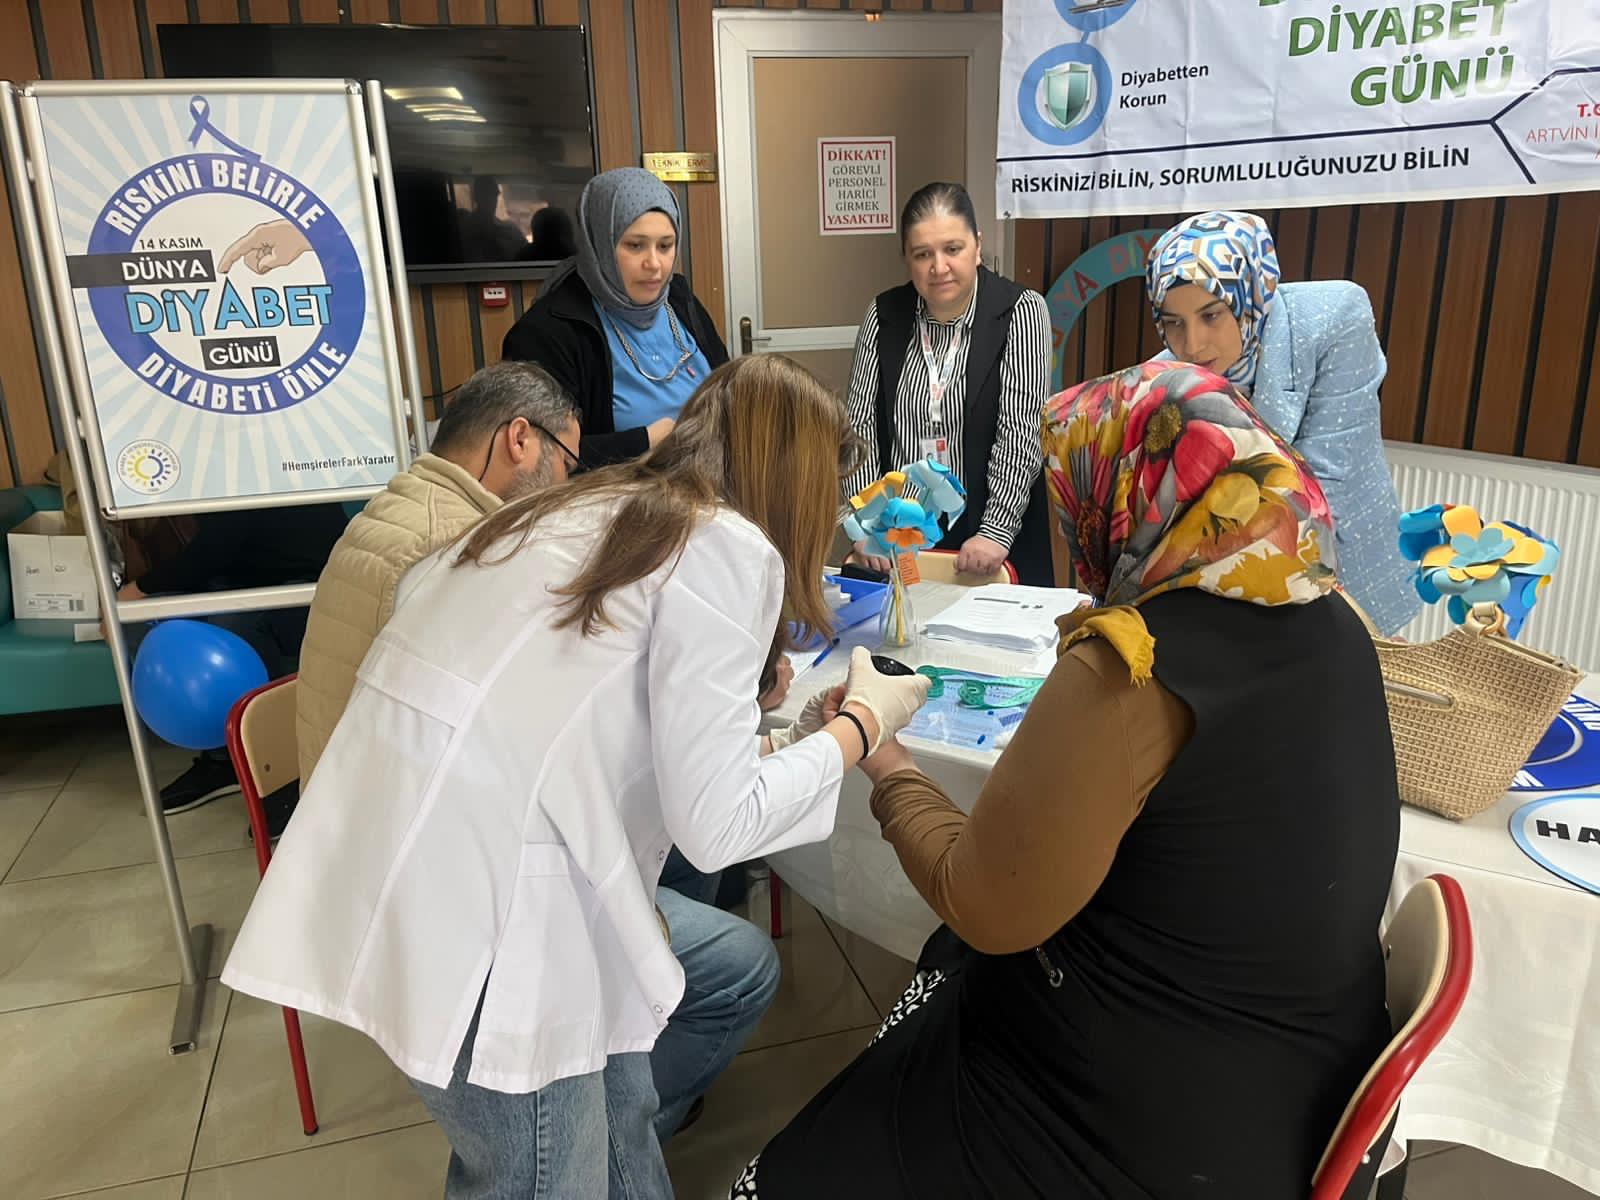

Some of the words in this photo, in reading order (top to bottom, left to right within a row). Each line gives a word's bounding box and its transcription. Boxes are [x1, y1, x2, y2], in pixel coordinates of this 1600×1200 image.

[1289, 0, 1518, 56] DİYABET
[1121, 65, 1209, 89] Diyabetten
[1351, 46, 1514, 106] GÜNÜ
[1119, 94, 1167, 109] Korun
[828, 147, 886, 161] DİKKAT!
[832, 164, 881, 175] GÖREVLİ
[1011, 172, 1097, 194] RİSKİNİZİ
[1099, 167, 1154, 190] BİLİN,
[1160, 153, 1396, 187] SORUMLULUĞUNUZU
[1404, 146, 1470, 170] BİLİN
[828, 177, 886, 188] PERSONEL
[104, 160, 201, 236] RİSKİNİ
[211, 159, 325, 230] BELİRLE
[838, 189, 876, 199] HARİCİ
[835, 201, 879, 211] GİRMEK
[827, 213, 889, 225] YASAKTIR
[138, 239, 157, 250] 14
[160, 237, 203, 249] KASIM
[121, 257, 209, 282] DÜNYA
[124, 278, 334, 336] DİYABET
[208, 343, 275, 365] GÜNÜ
[137, 350, 278, 411] DİYABETİ
[280, 341, 347, 398] ÖNLE
[281, 455, 395, 472] #HemşirelerFarkYaratır
